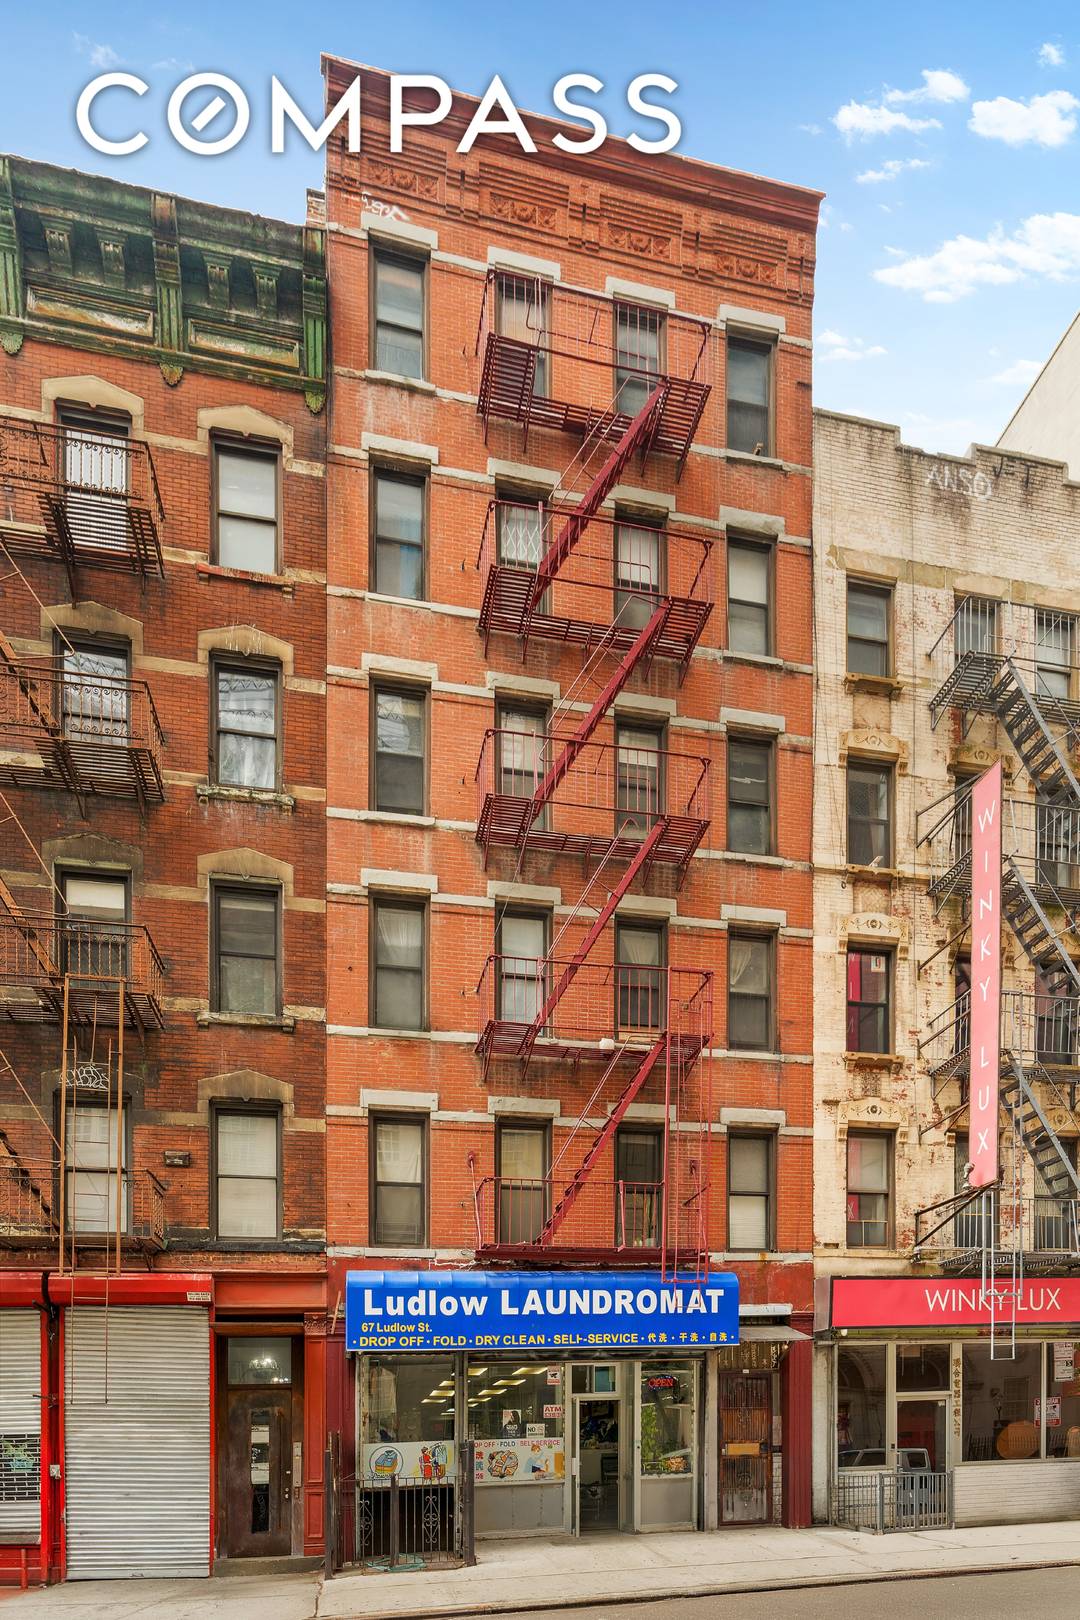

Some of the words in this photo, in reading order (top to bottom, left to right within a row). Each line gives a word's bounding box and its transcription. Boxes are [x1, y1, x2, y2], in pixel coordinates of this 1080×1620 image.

[978, 799, 996, 1002] WINKY
[977, 1046, 990, 1156] LUX
[364, 1289, 488, 1316] Ludlow
[501, 1288, 724, 1316] LAUNDROMAT
[924, 1288, 1008, 1312] WINKY
[1017, 1287, 1061, 1311] LUX
[361, 1322, 374, 1333] 67
[376, 1322, 415, 1333] Ludlow
[418, 1322, 433, 1333] St.
[359, 1336, 396, 1347] DROP
[399, 1336, 424, 1347] OFF
[433, 1335, 467, 1346] FOLD
[475, 1335, 500, 1346] DRY
[503, 1334, 545, 1346] CLEAN
[648, 1378, 674, 1388] OPEN
[483, 1441, 496, 1449] OFF
